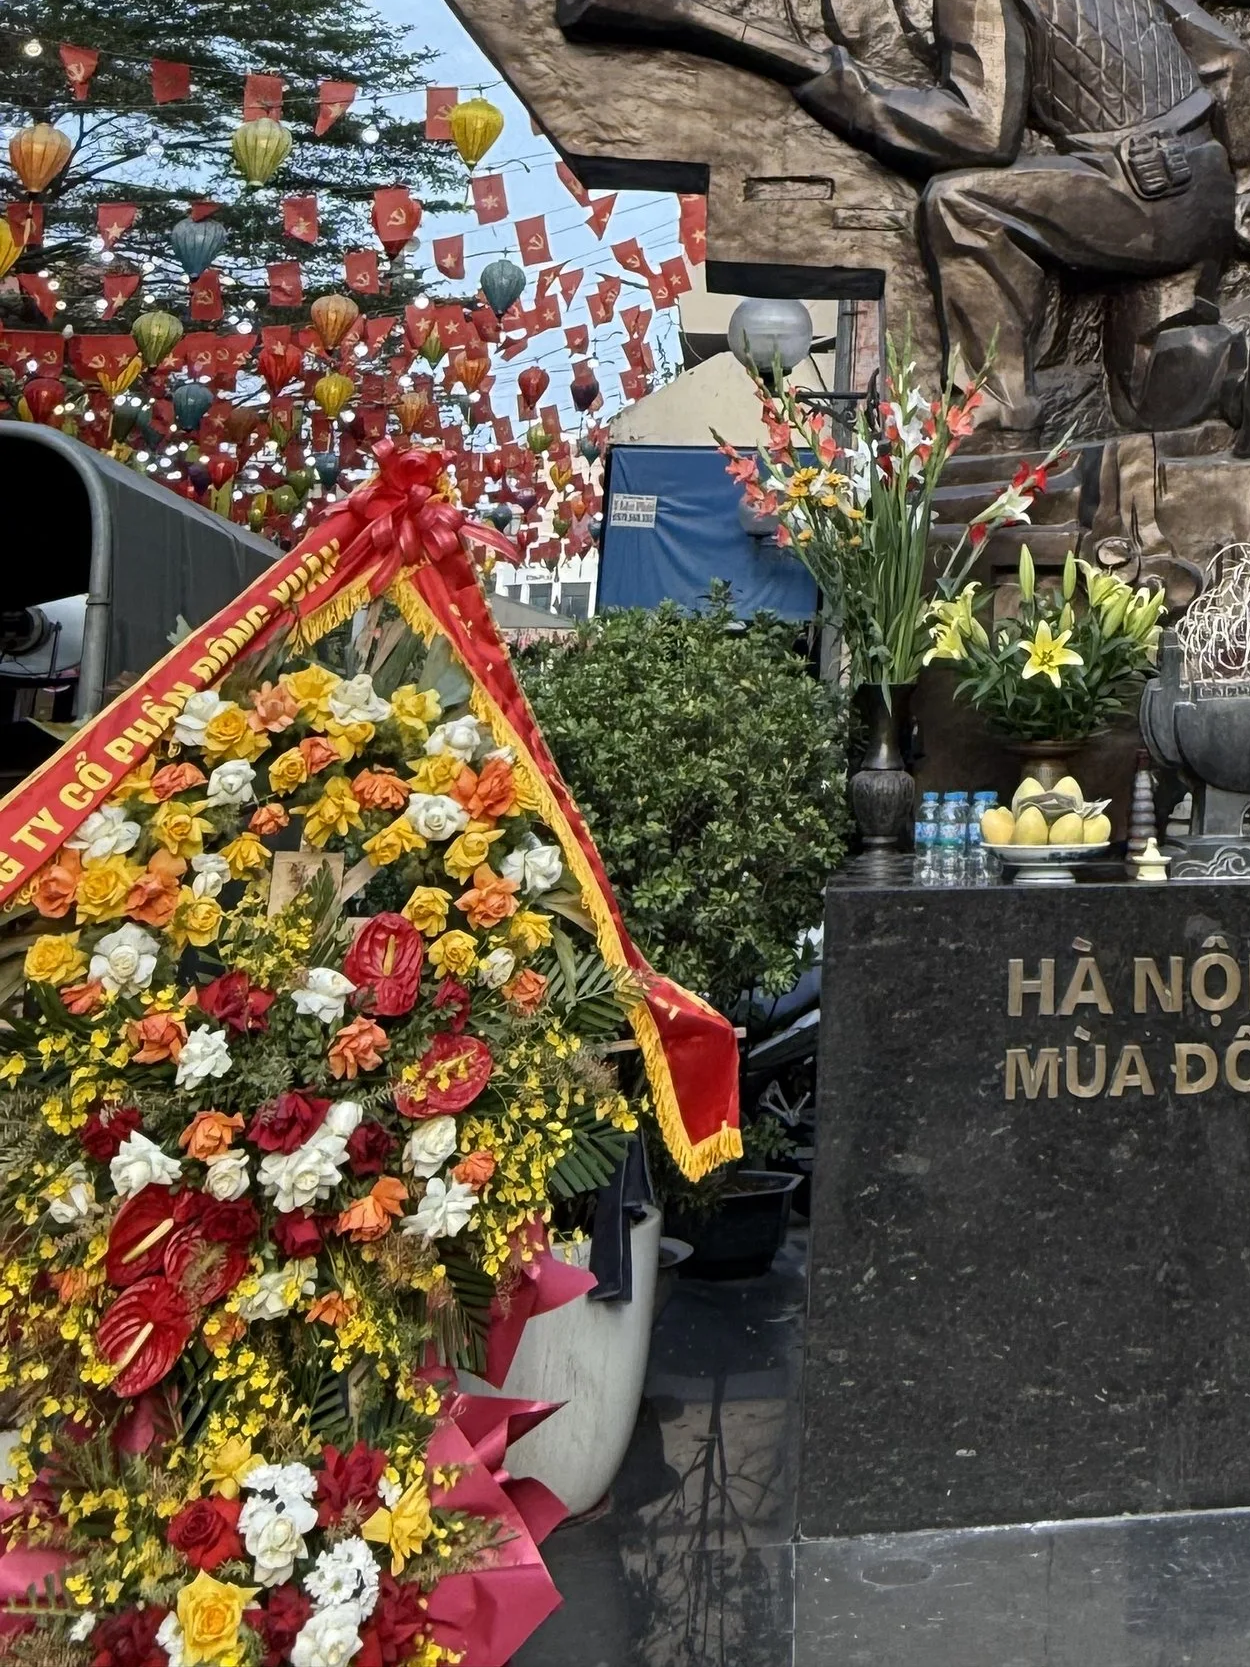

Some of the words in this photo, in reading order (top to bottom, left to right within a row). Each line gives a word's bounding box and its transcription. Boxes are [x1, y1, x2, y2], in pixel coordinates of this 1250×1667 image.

[11, 807, 65, 852] TY
[59, 750, 114, 811] CỔ
[104, 681, 197, 764] PHẦN
[1007, 937, 1114, 1017] HÀ
[1005, 1026, 1156, 1100] MÙA
